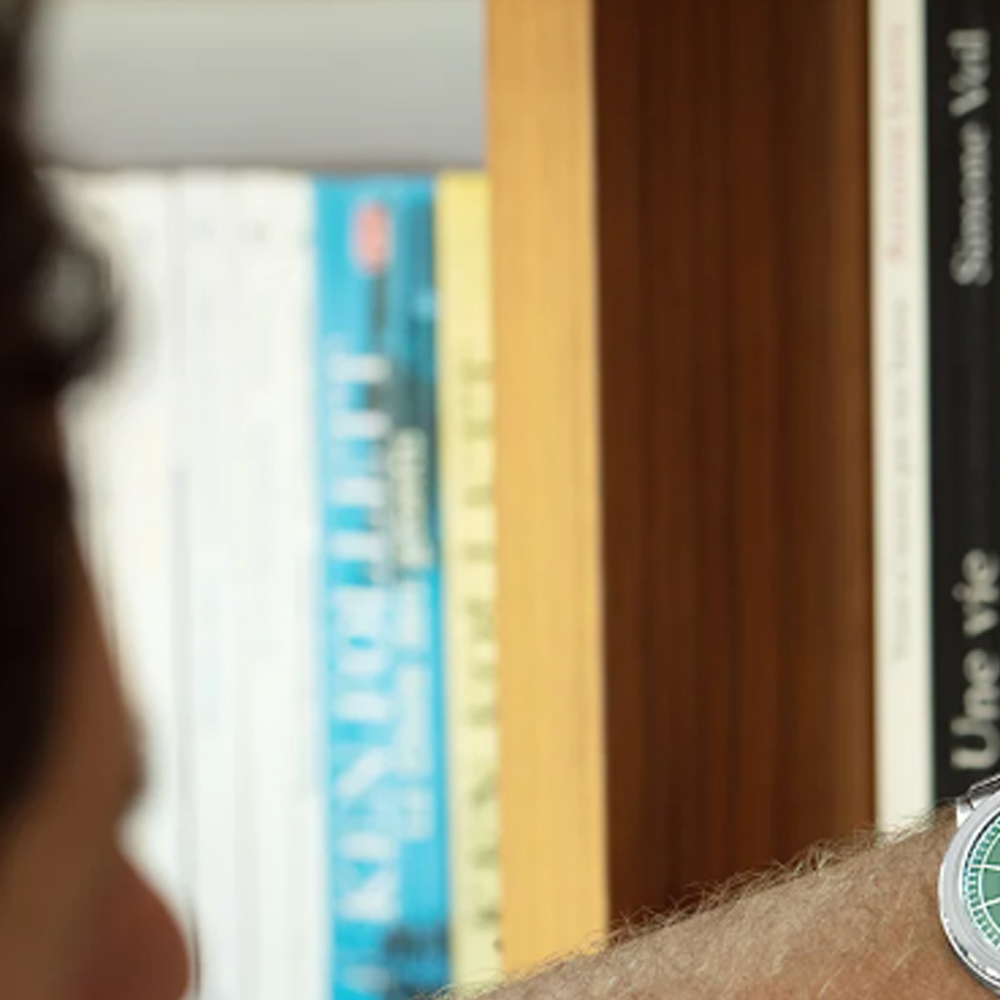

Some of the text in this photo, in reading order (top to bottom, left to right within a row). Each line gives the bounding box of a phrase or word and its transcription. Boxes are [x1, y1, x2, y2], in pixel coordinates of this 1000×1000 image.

[947, 27, 993, 286] Simone Veil
[951, 549, 1000, 638] vie
